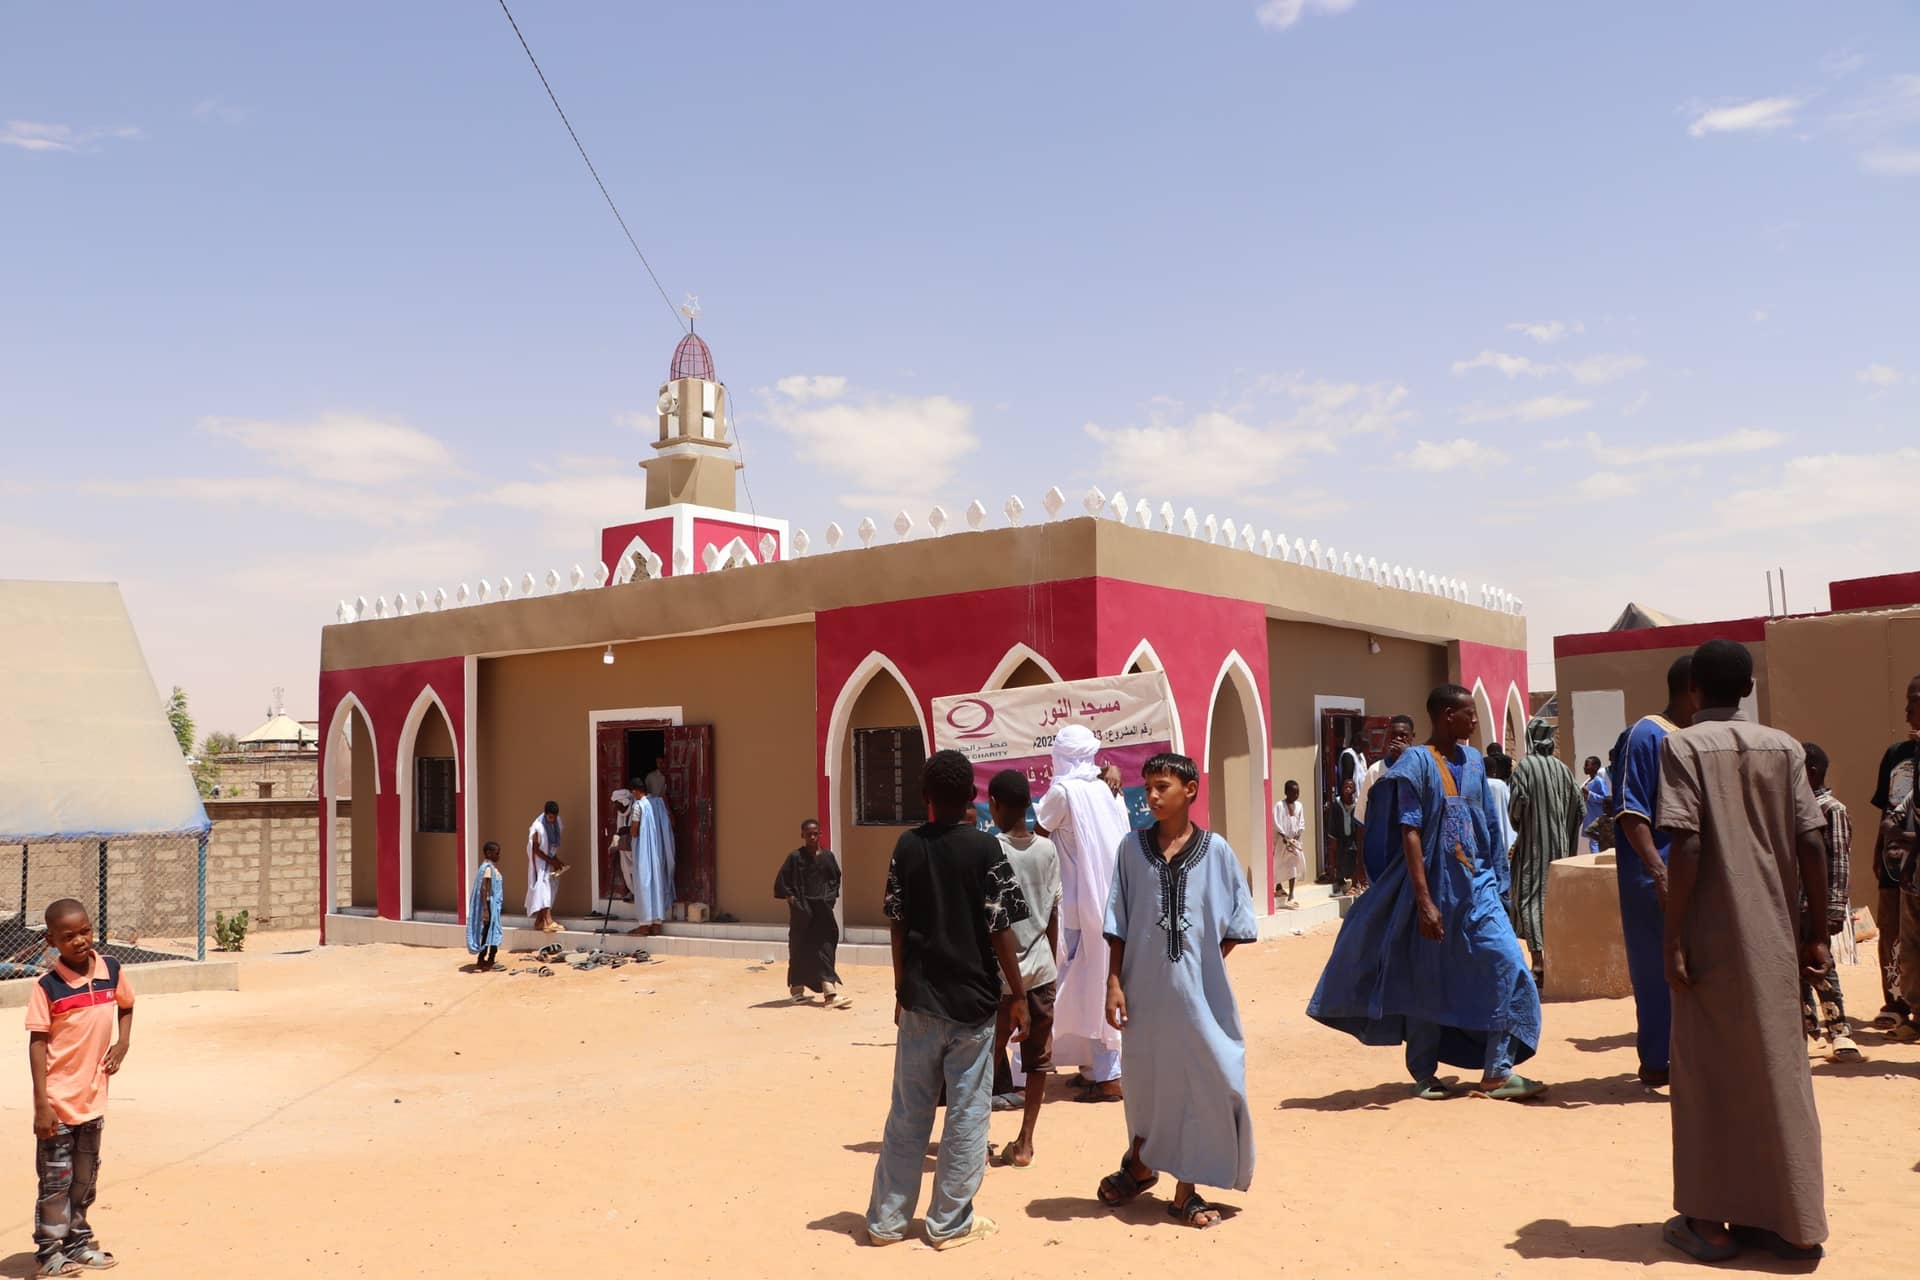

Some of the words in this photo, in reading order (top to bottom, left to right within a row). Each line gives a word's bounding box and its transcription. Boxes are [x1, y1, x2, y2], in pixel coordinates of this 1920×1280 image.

[1039, 697, 1072, 727] النور
[1080, 699, 1121, 721] مسجد
[1141, 722, 1153, 739] رقم
[972, 750, 1009, 761] CHARITY
